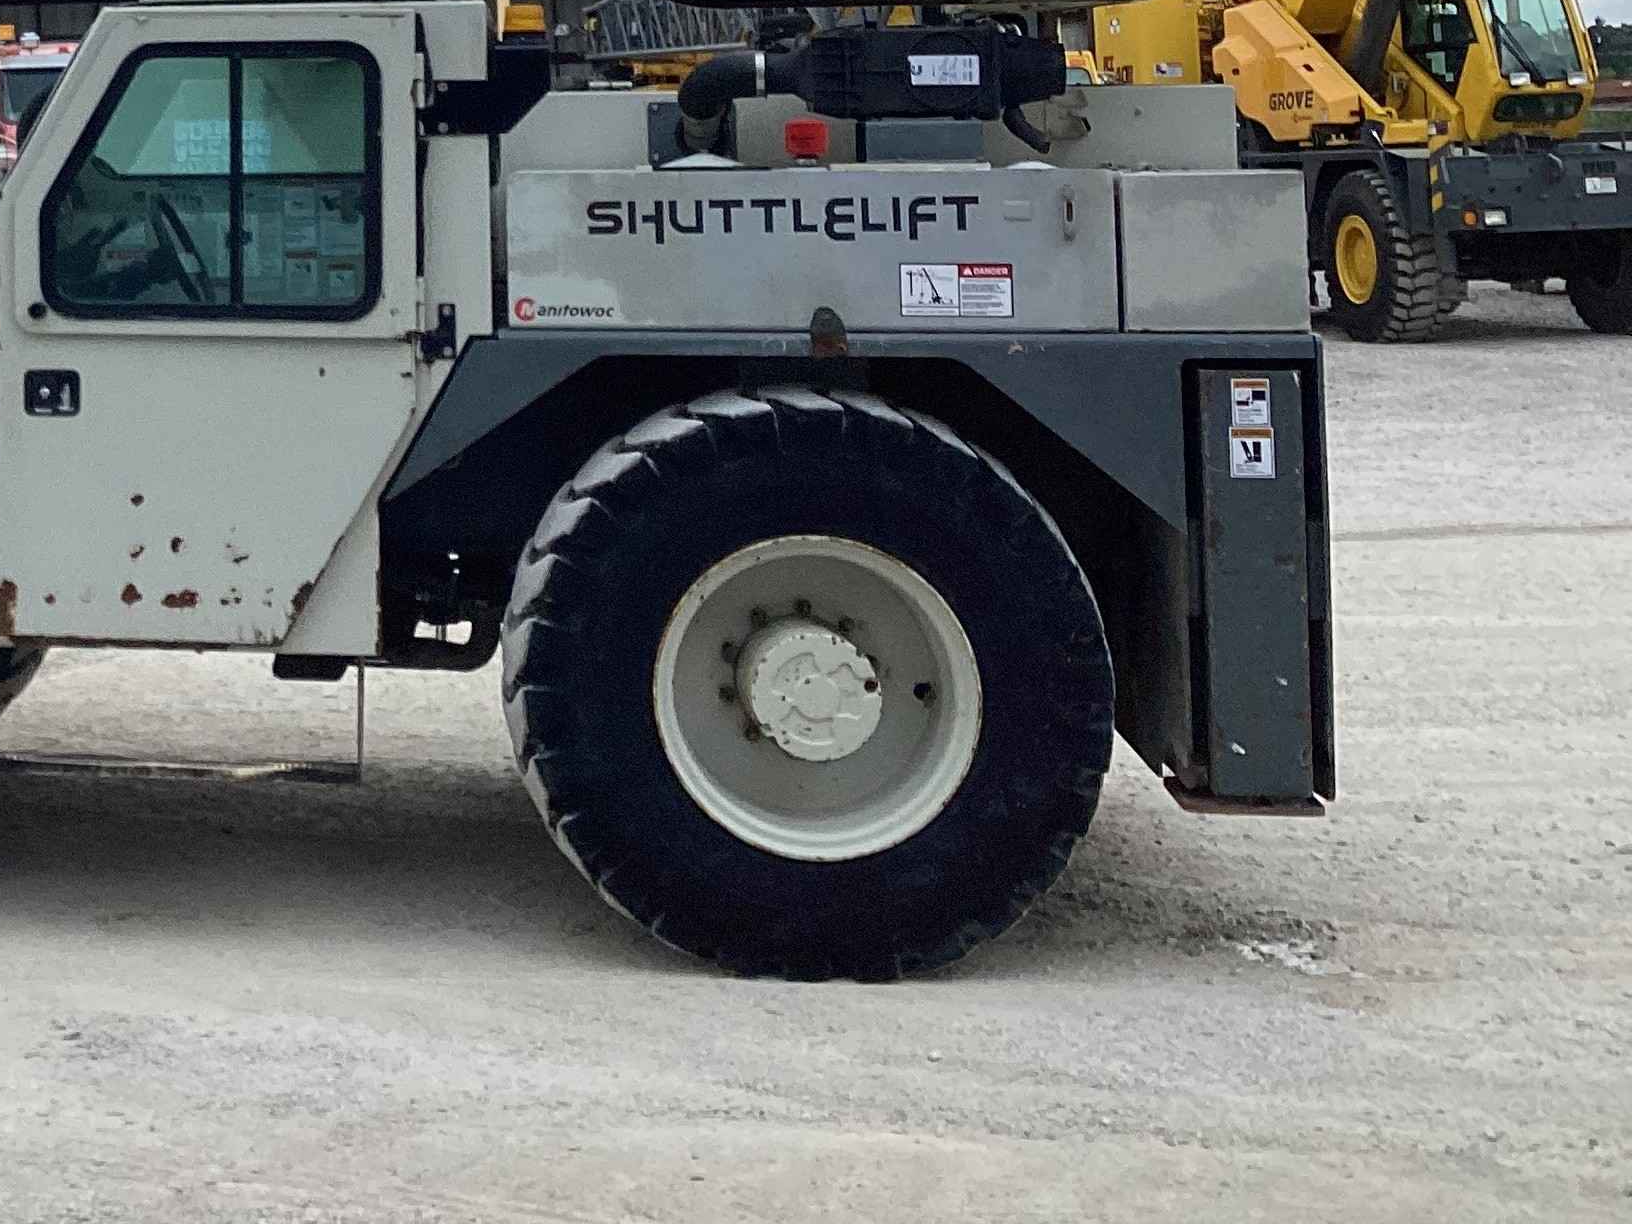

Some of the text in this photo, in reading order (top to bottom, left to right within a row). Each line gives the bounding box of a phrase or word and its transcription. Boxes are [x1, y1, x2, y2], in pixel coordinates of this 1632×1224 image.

[1268, 89, 1314, 111] GROVE
[586, 195, 980, 245] SHUTTLELIFT
[973, 266, 1009, 276] DANGER
[514, 297, 616, 322] Manitowoc
